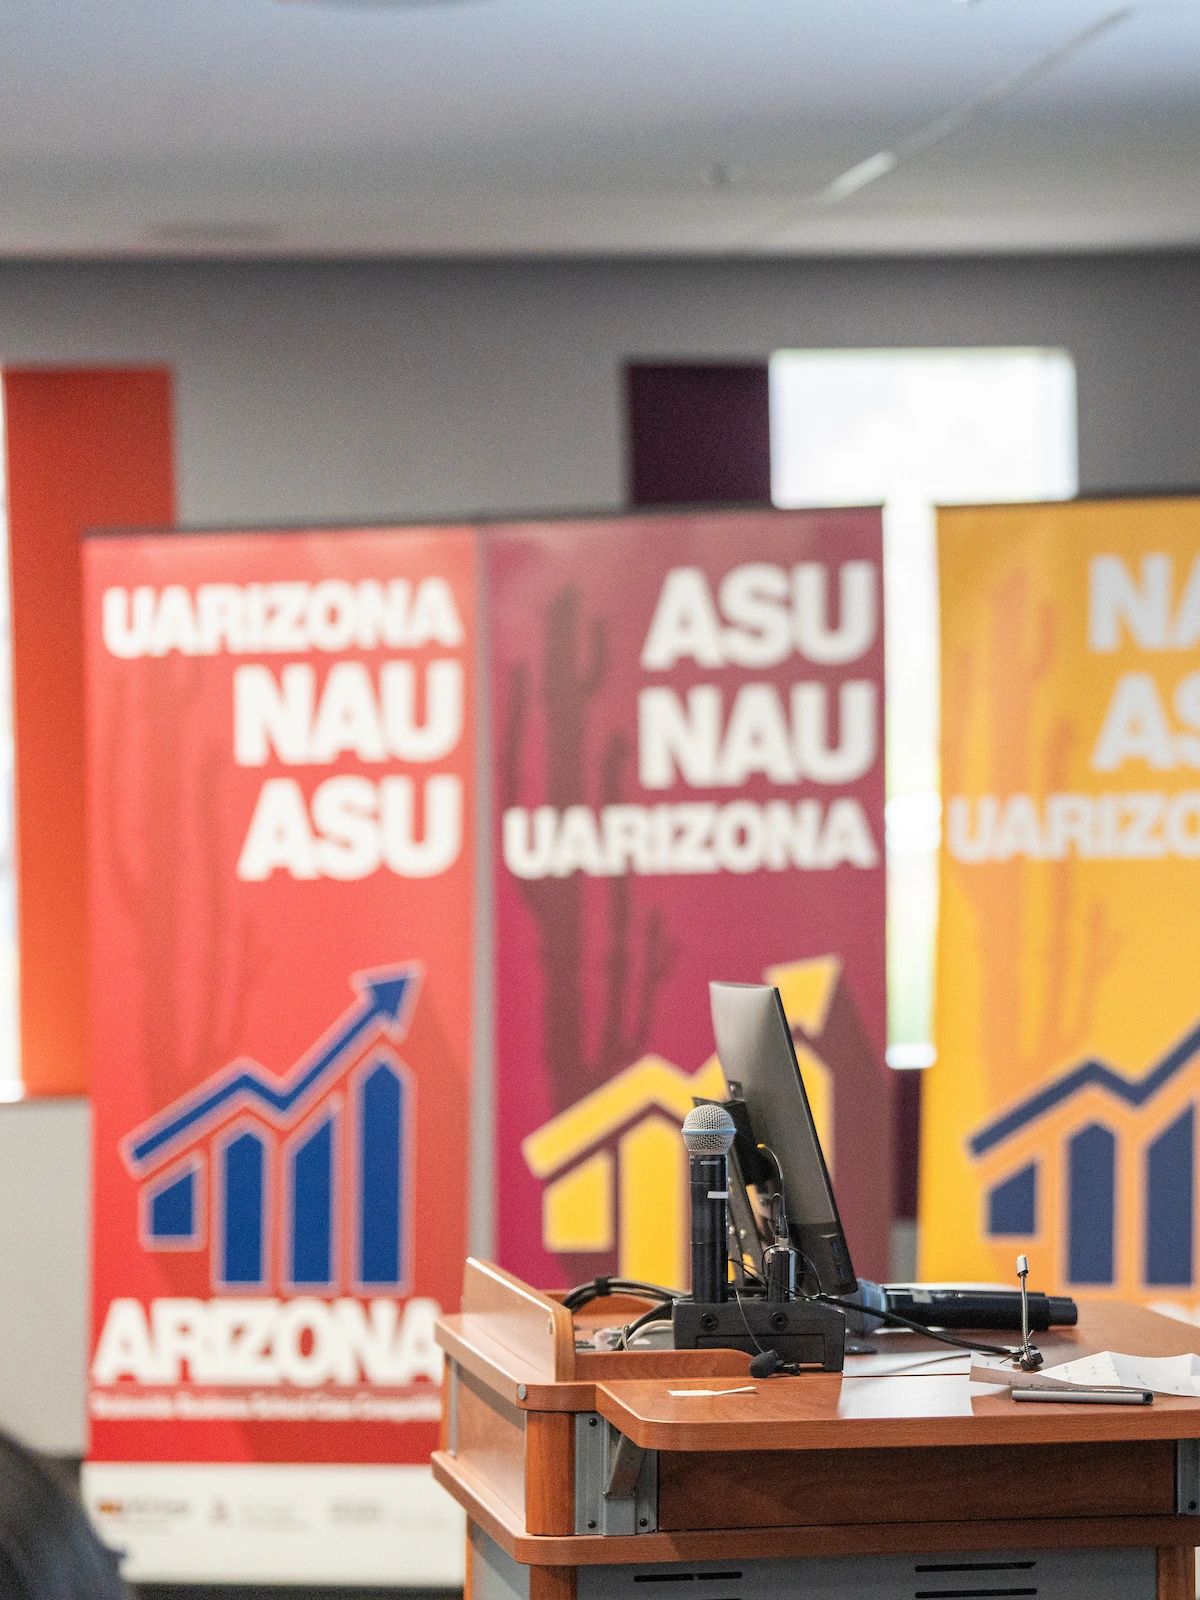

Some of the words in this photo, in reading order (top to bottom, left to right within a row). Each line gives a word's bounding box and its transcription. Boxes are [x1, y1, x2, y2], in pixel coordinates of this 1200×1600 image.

[102, 577, 463, 658] UARIZONA
[641, 561, 877, 670] ASU
[233, 660, 463, 766] NAU
[638, 681, 878, 788] NAU
[236, 775, 463, 881] ASU
[503, 799, 878, 877] UARIZONA
[92, 1297, 443, 1387] ARIZONA
